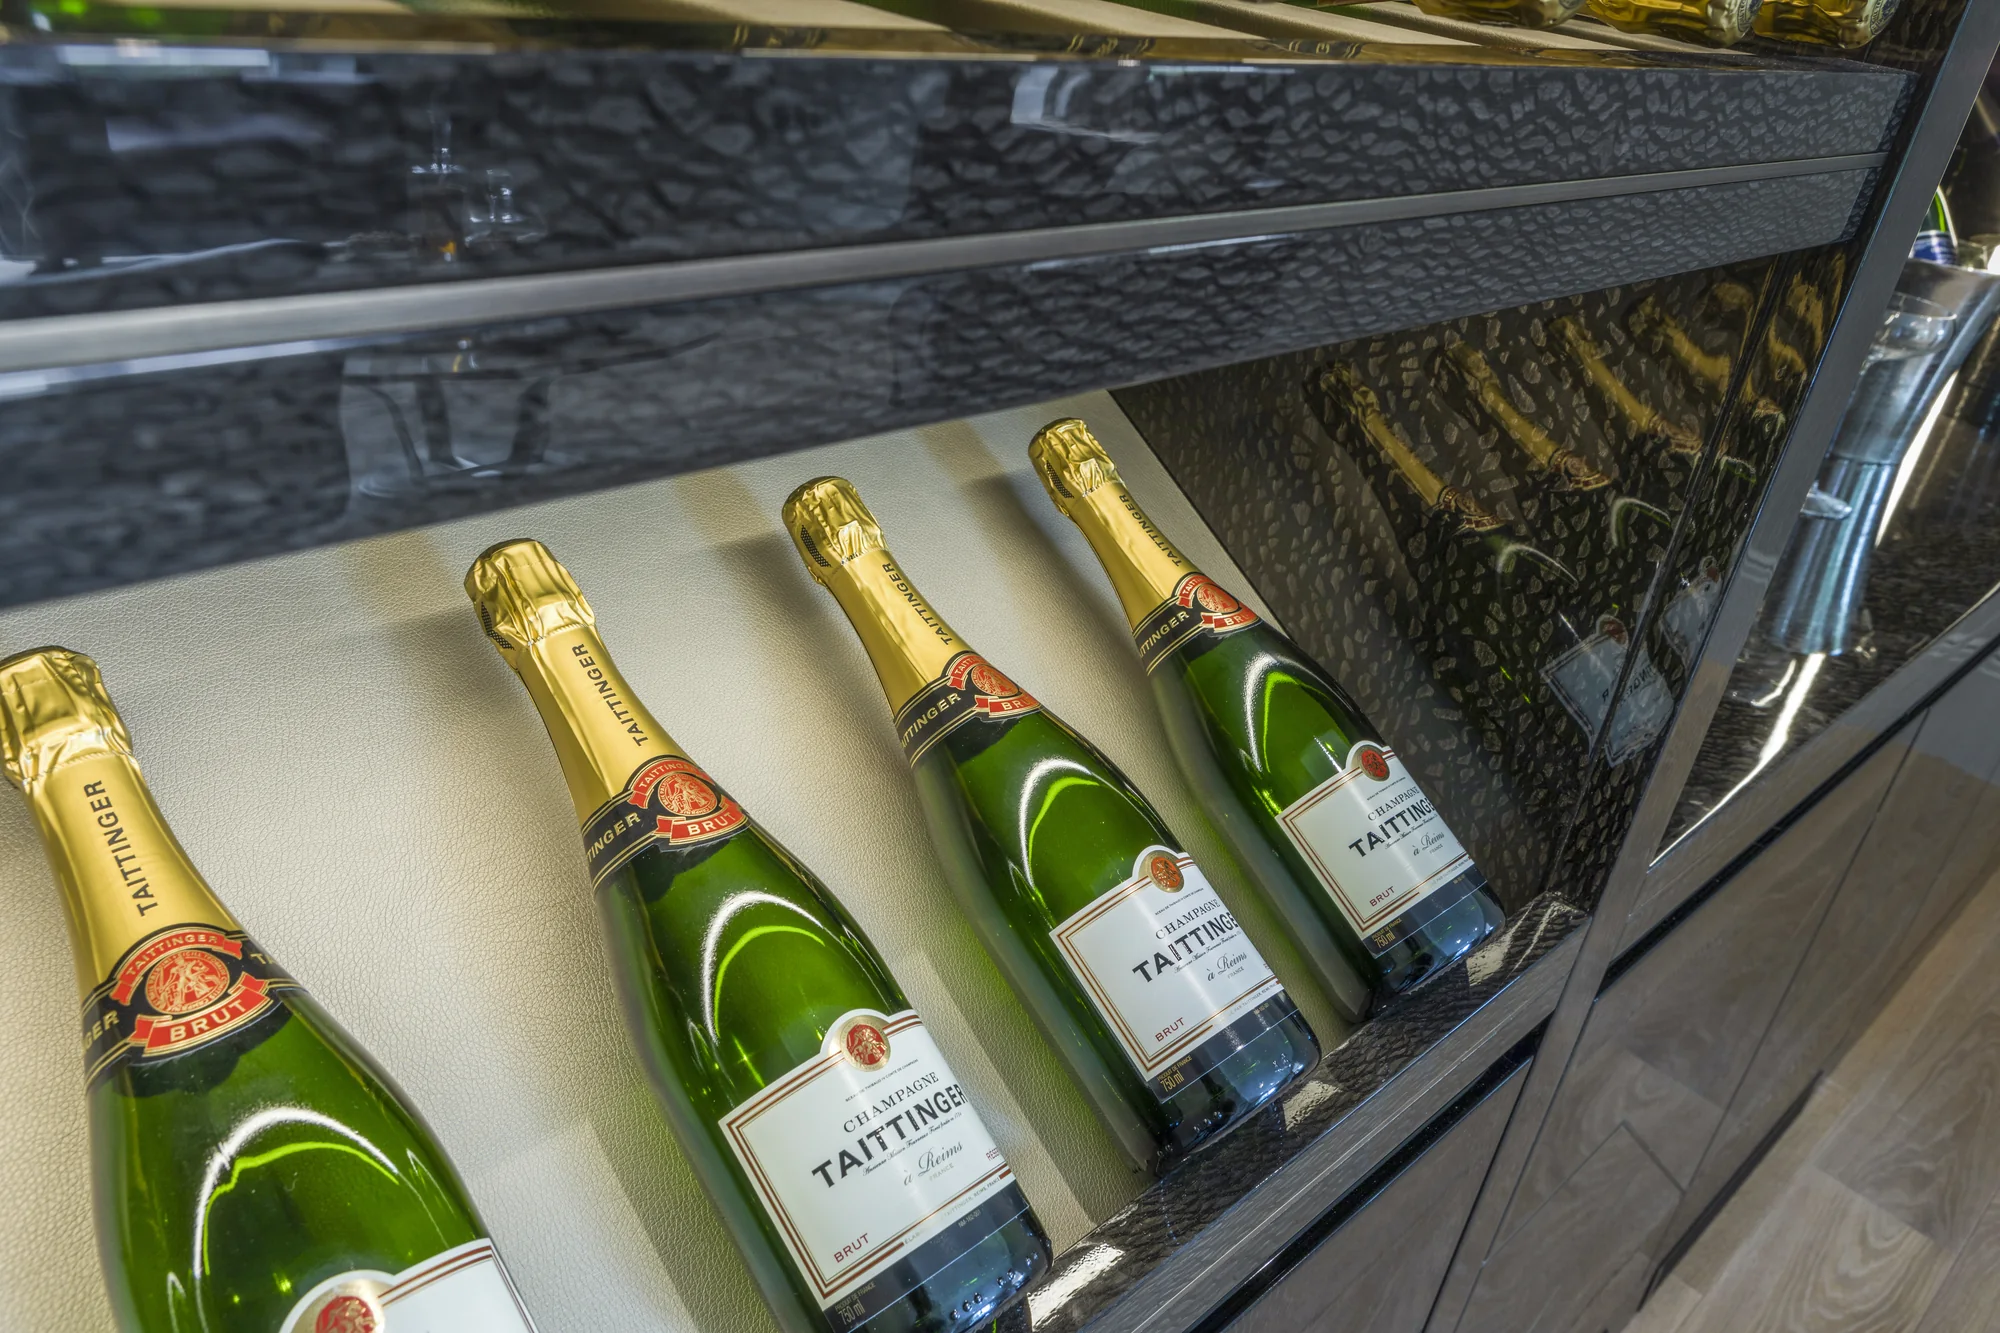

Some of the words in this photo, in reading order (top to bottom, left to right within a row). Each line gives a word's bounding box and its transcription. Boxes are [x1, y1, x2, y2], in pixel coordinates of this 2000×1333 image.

[1119, 494, 1182, 566] TAITTINGER
[882, 562, 953, 645] TAITTINGER
[571, 643, 649, 747] TAITTINGER
[1367, 786, 1420, 821] CHAMPAGNE
[687, 811, 738, 837] BRUT
[83, 780, 158, 917] TAITTINGER
[1369, 886, 1395, 907] BRUT
[1155, 898, 1221, 940] CHAMPAGNE
[125, 933, 219, 976] TAITTINGER
[1374, 935, 1388, 948] 750
[1386, 930, 1396, 942] ml
[1207, 968, 1216, 981] à
[1217, 952, 1248, 974] Reims
[169, 999, 248, 1042] BRUT
[1154, 1017, 1186, 1042] BRUT
[1160, 1076, 1176, 1092] 750
[1174, 1070, 1185, 1085] ml
[843, 1072, 939, 1133] CHAMPAGNE
[811, 1083, 967, 1188] TAITTINGER
[904, 1170, 913, 1186] à
[918, 1142, 963, 1177] Reims
[929, 1162, 954, 1181] FRANCE
[834, 1233, 870, 1263] BRUT
[838, 1306, 856, 1325] 750
[853, 1299, 866, 1316] ml
